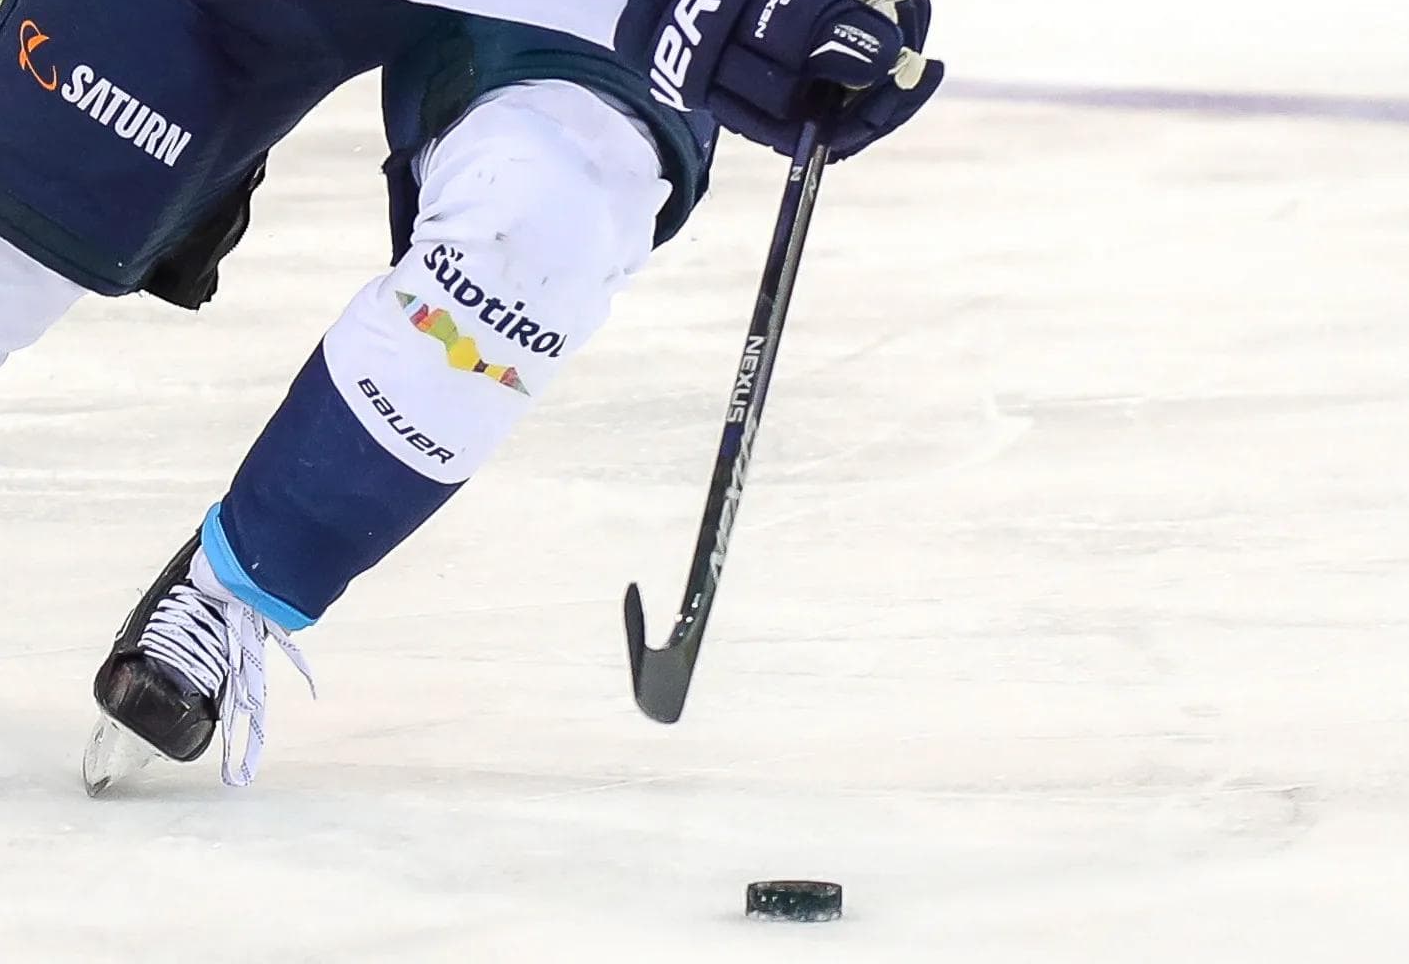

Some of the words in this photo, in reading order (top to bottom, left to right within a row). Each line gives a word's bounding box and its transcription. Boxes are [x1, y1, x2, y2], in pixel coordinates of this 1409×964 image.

[61, 64, 192, 168] SATURN
[356, 377, 456, 465] BAUER
[727, 334, 765, 425] NEXUS
